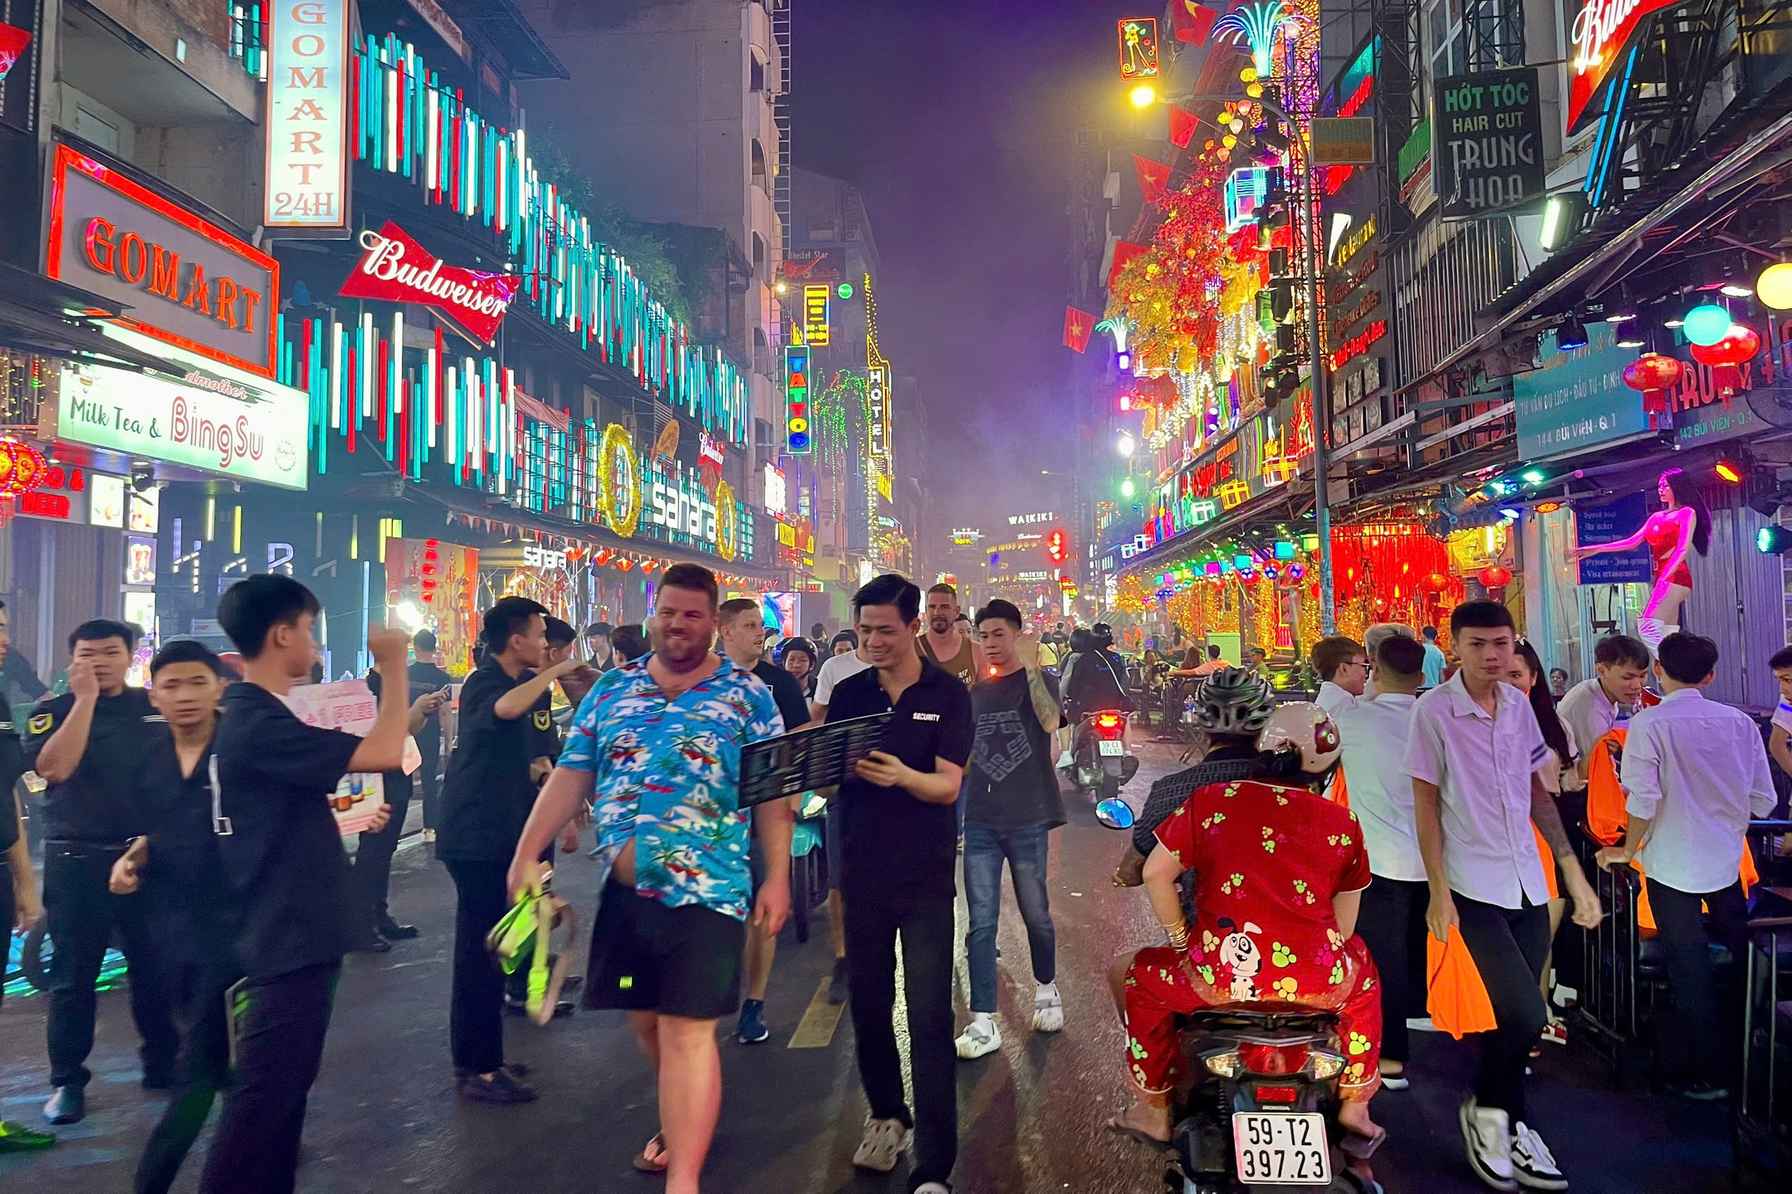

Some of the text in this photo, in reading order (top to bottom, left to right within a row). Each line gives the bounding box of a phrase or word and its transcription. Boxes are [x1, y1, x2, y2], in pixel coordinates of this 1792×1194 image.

[286, 2, 328, 186] GOMART
[1489, 78, 1529, 108] TÓC
[1452, 111, 1525, 134] HAIR CUT
[1447, 132, 1536, 170] TRUNG
[273, 192, 335, 217] 24H
[84, 215, 263, 335] GOMART
[360, 230, 508, 318] Budweiser
[789, 355, 808, 449] TATTOO
[869, 370, 883, 454] HOTEL
[70, 395, 265, 468] Milk Tea & BingSu
[653, 481, 717, 544] sahara
[1008, 511, 1053, 525] WAIKIKI
[523, 543, 567, 570] sahara
[1247, 1117, 1313, 1147] 59-T2
[1242, 1150, 1324, 1180] 397.23
